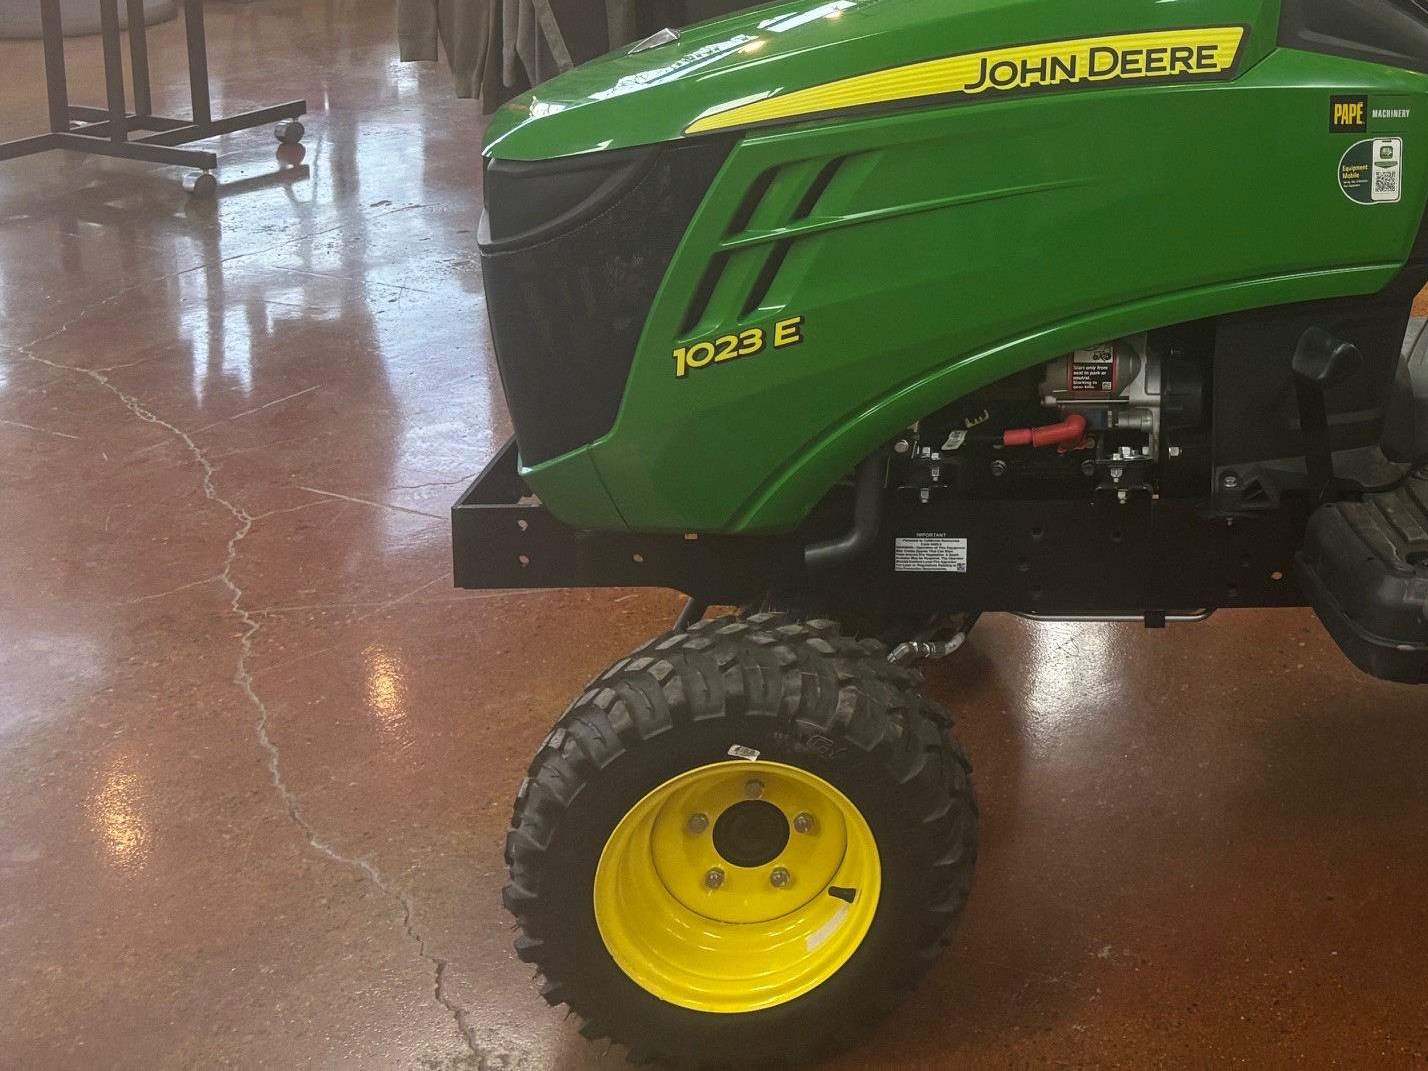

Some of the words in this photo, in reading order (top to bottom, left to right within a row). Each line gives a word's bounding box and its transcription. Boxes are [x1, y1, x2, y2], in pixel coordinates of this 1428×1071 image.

[964, 54, 1077, 90] JOHN
[1088, 44, 1218, 78] DEERE
[1372, 110, 1410, 118] MACHINERY
[672, 328, 764, 378] 1023
[774, 315, 802, 347] E
